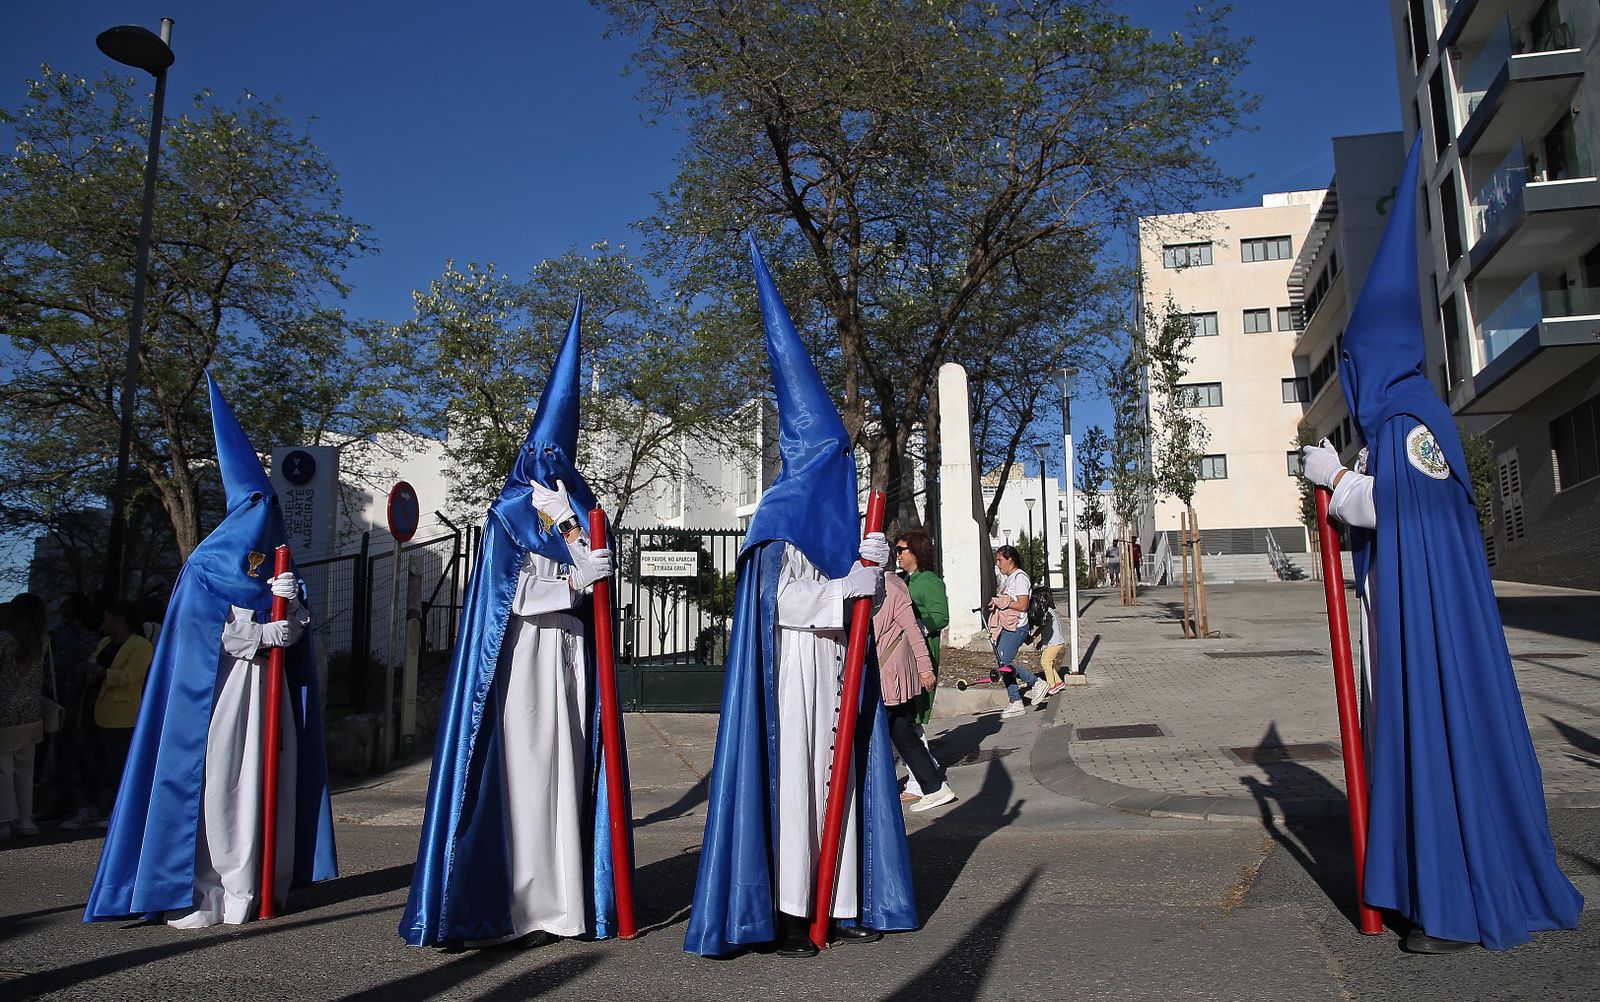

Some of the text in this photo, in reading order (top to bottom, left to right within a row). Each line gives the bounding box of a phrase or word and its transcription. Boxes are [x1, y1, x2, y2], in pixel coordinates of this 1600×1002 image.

[293, 489, 304, 534] DE ARTE
[302, 489, 314, 550] ALGECIRAS
